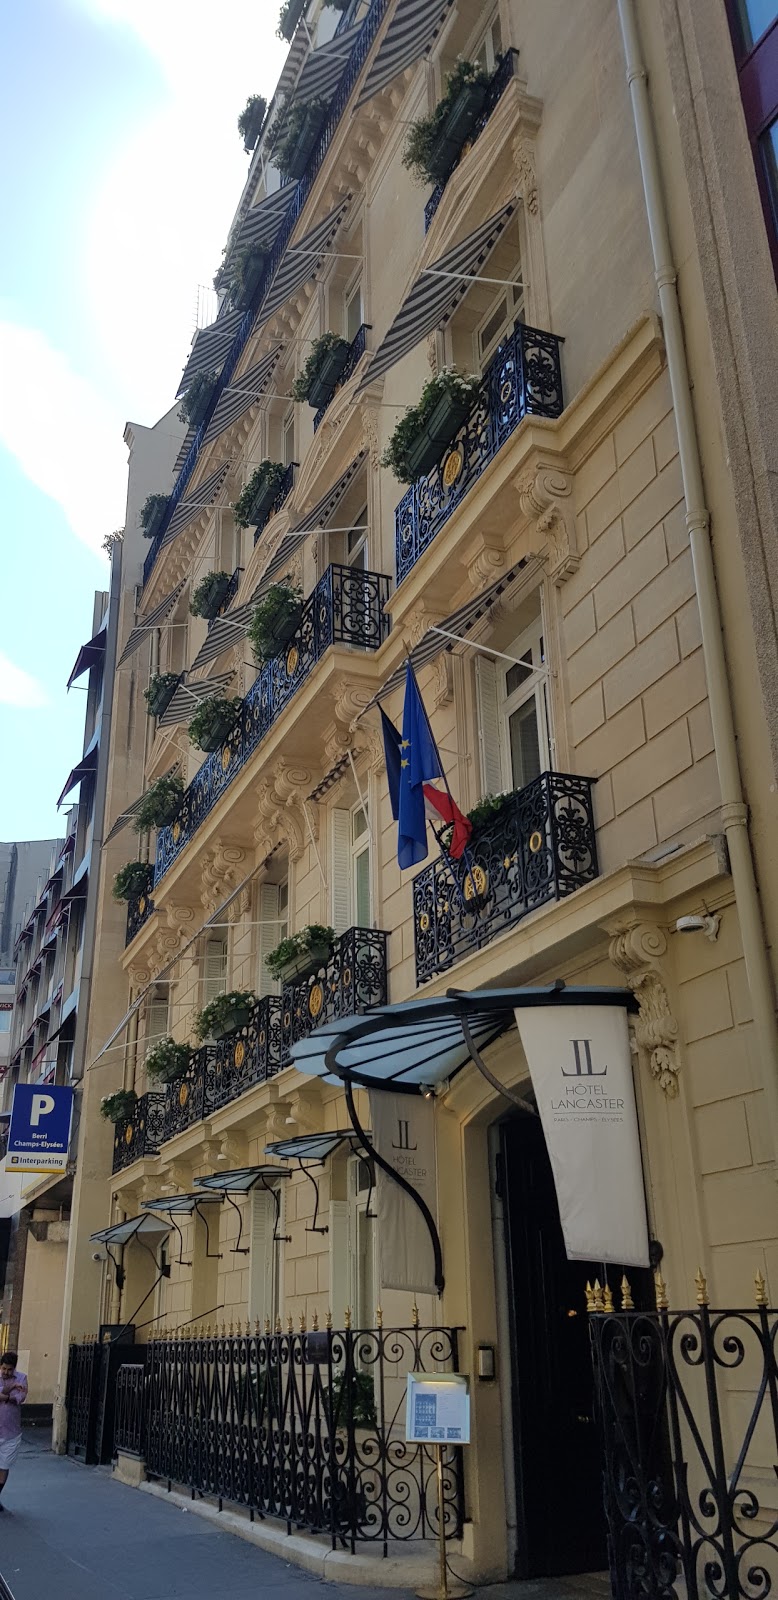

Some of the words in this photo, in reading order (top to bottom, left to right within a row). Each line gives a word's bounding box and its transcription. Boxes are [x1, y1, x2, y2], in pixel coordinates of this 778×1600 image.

[565, 1083, 608, 1096] HÔTEL
[30, 1094, 55, 1126] P
[551, 1098, 625, 1110] LANCASTER
[32, 1132, 48, 1140] Berri
[19, 1156, 63, 1166] Interparking
[393, 1165, 427, 1177] NCASTER
